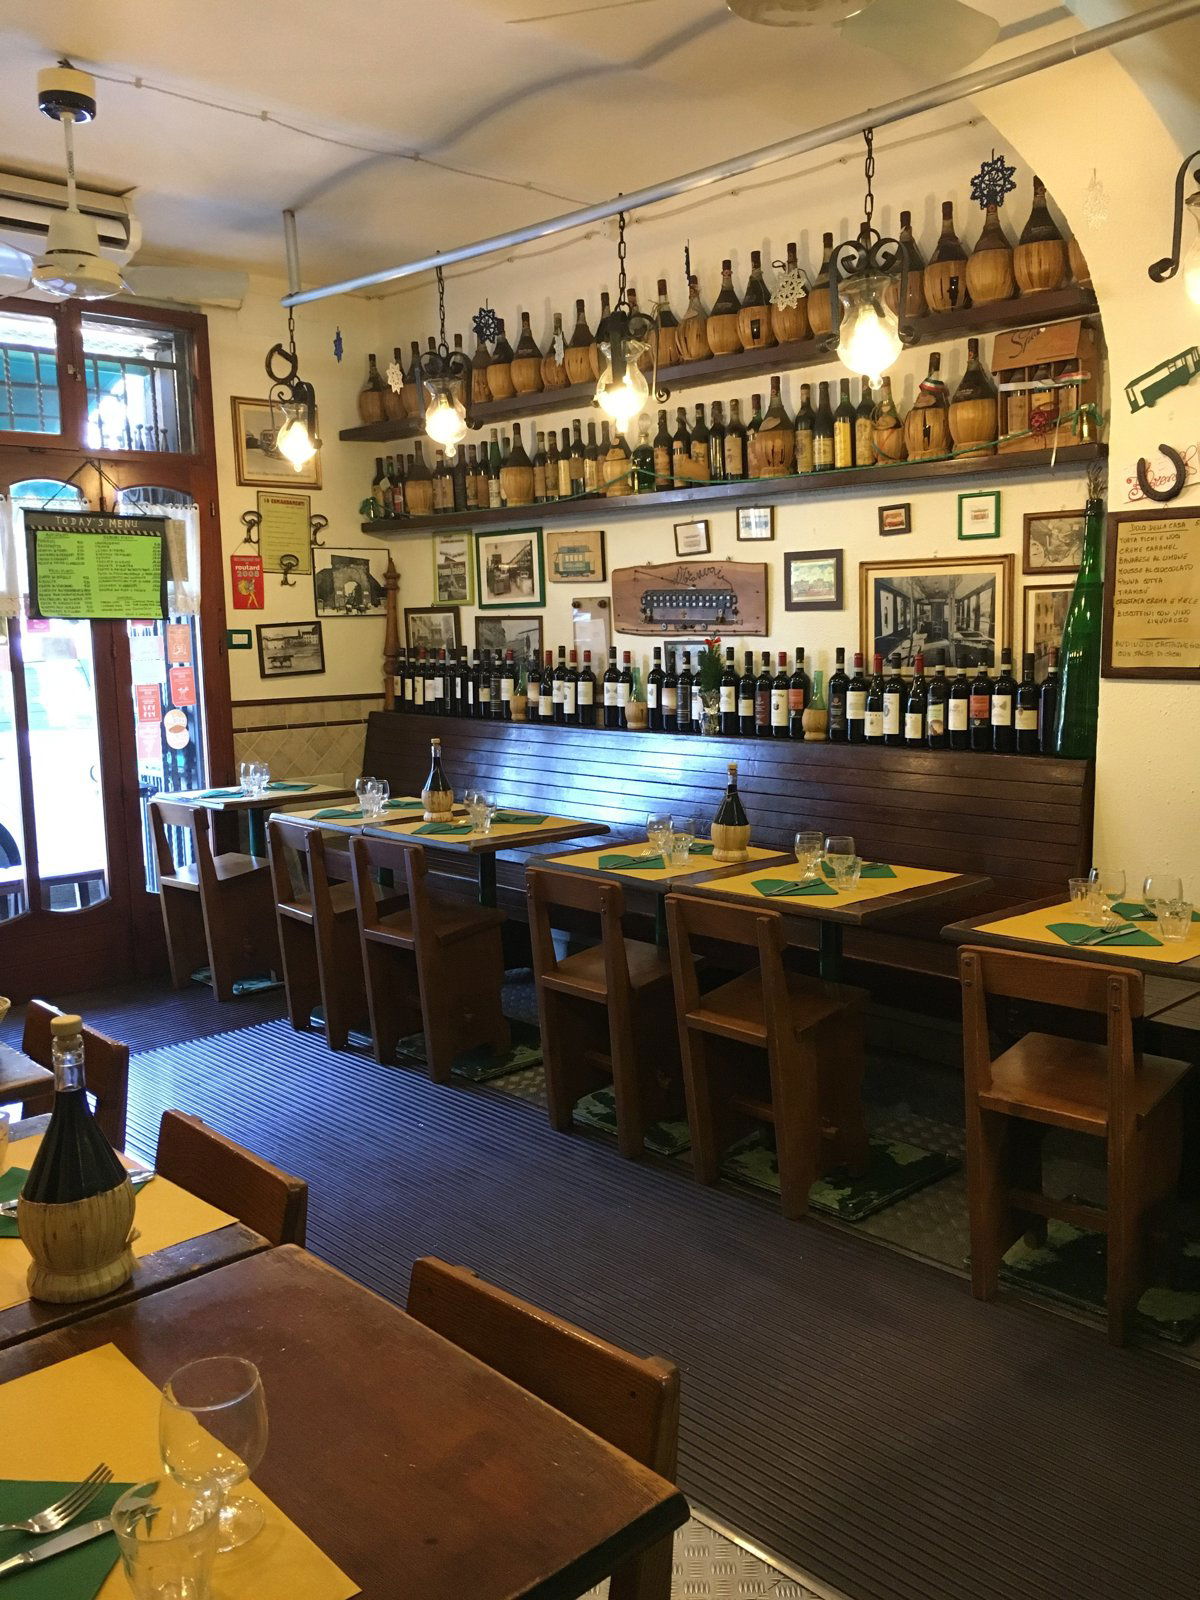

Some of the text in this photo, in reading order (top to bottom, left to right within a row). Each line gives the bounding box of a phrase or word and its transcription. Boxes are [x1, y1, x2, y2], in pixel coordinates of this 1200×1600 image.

[56, 516, 138, 528] TODAY'S MENU
[1119, 544, 1178, 554] CREME CARAMEL
[1118, 557, 1150, 565] BAVARESE
[1162, 553, 1188, 561] LIMONE
[1147, 617, 1189, 625] LIQUOROSO
